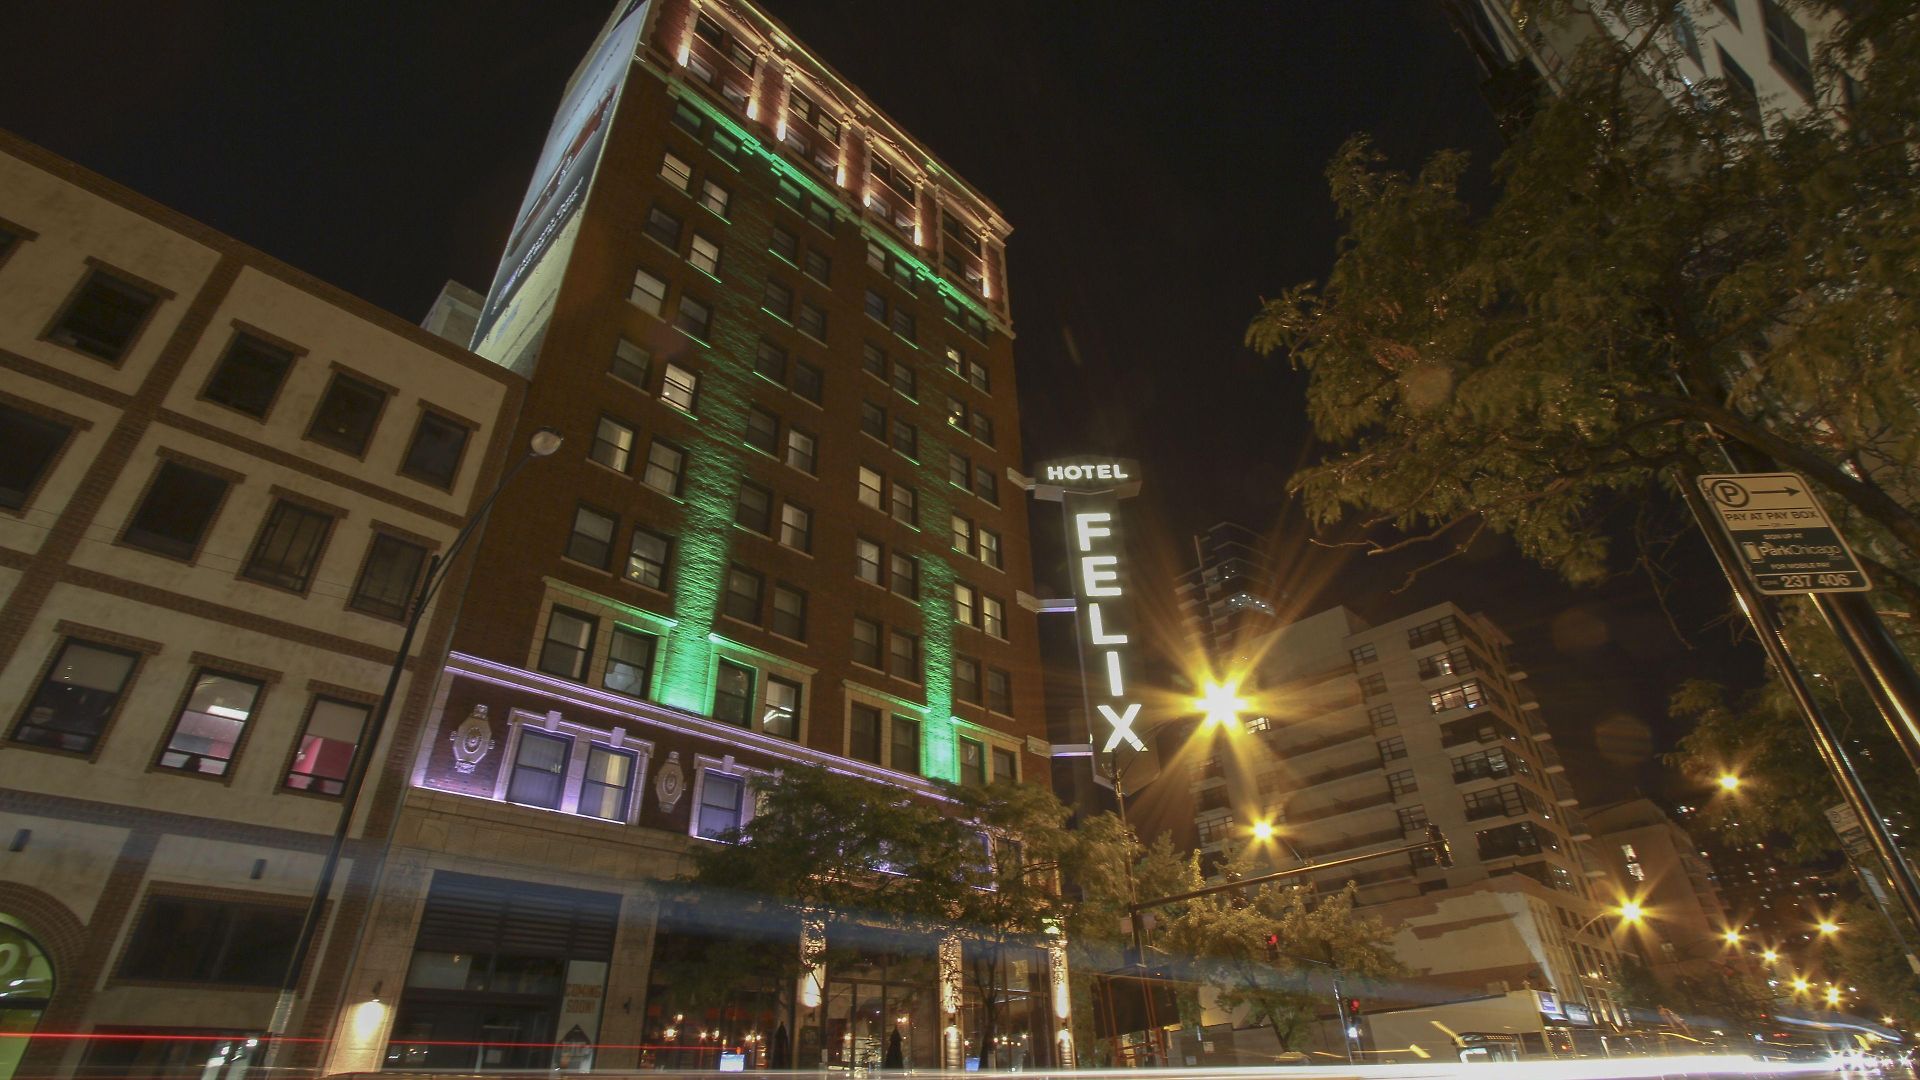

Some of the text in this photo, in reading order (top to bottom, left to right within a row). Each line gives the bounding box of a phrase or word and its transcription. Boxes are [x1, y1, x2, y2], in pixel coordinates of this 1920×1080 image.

[1047, 464, 1129, 480] HOTEL
[1718, 485, 1739, 502] P
[1725, 510, 1819, 521] PAY AT PAY BOX
[1758, 544, 1841, 556] ParkChicago
[1780, 574, 1812, 588] 237
[1818, 573, 1851, 587] 406
[1076, 512, 1148, 752] FELIX
[565, 983, 602, 998] COMING
